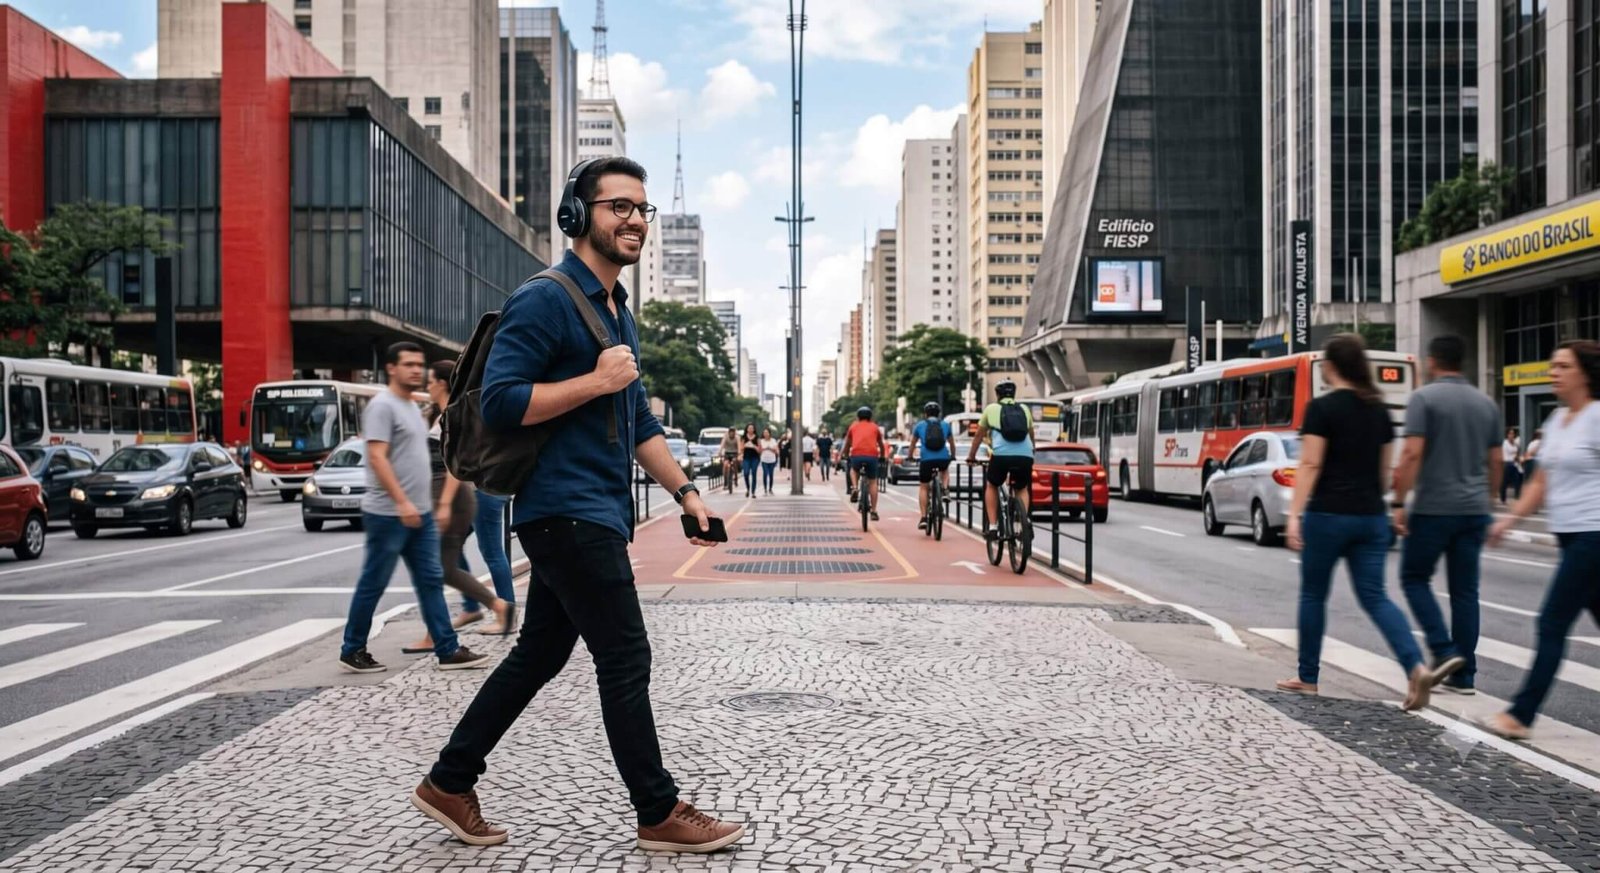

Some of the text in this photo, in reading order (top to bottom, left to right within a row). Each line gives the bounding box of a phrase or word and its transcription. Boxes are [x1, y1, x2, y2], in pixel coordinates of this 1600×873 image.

[1103, 234, 1149, 248] FIESP
[1479, 216, 1594, 266] BANCO DO BRASIL
[1296, 232, 1307, 344] AVENIDA PAULISTA
[1190, 335, 1200, 369] MASP
